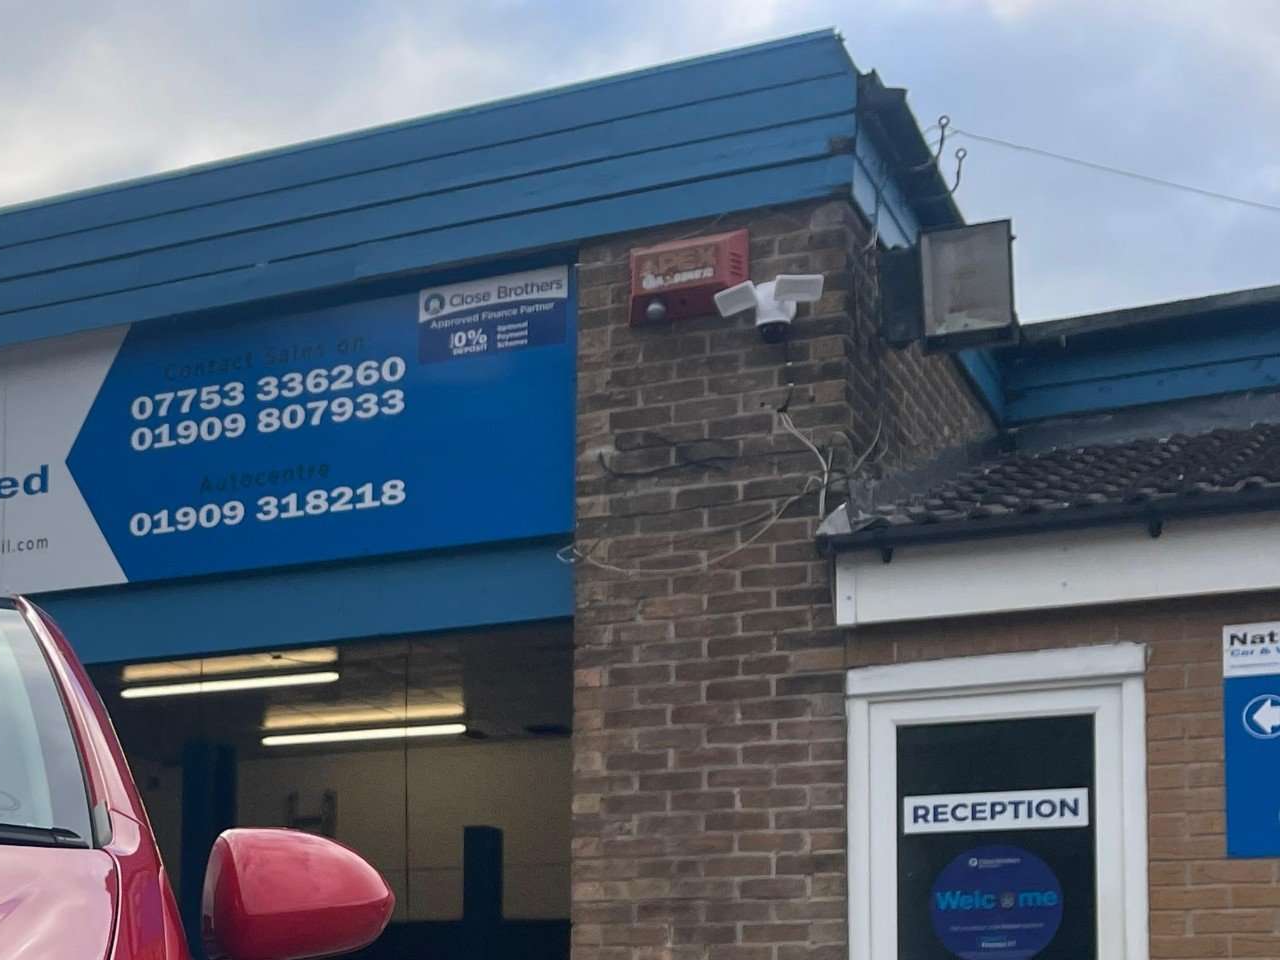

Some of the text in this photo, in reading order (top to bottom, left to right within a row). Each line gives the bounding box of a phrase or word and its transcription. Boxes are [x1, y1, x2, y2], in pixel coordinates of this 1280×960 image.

[449, 279, 563, 307] Close Brothers
[430, 302, 555, 329] Approved Finance Partner
[453, 328, 487, 348] 0%
[164, 350, 254, 382] Contact
[264, 343, 324, 368] Sales
[130, 355, 406, 420] 07753 336260
[130, 388, 406, 451] 01909 807933
[200, 462, 331, 494] Autocentre
[129, 479, 406, 537] 01909 318218
[912, 798, 1080, 824] RECEPTION
